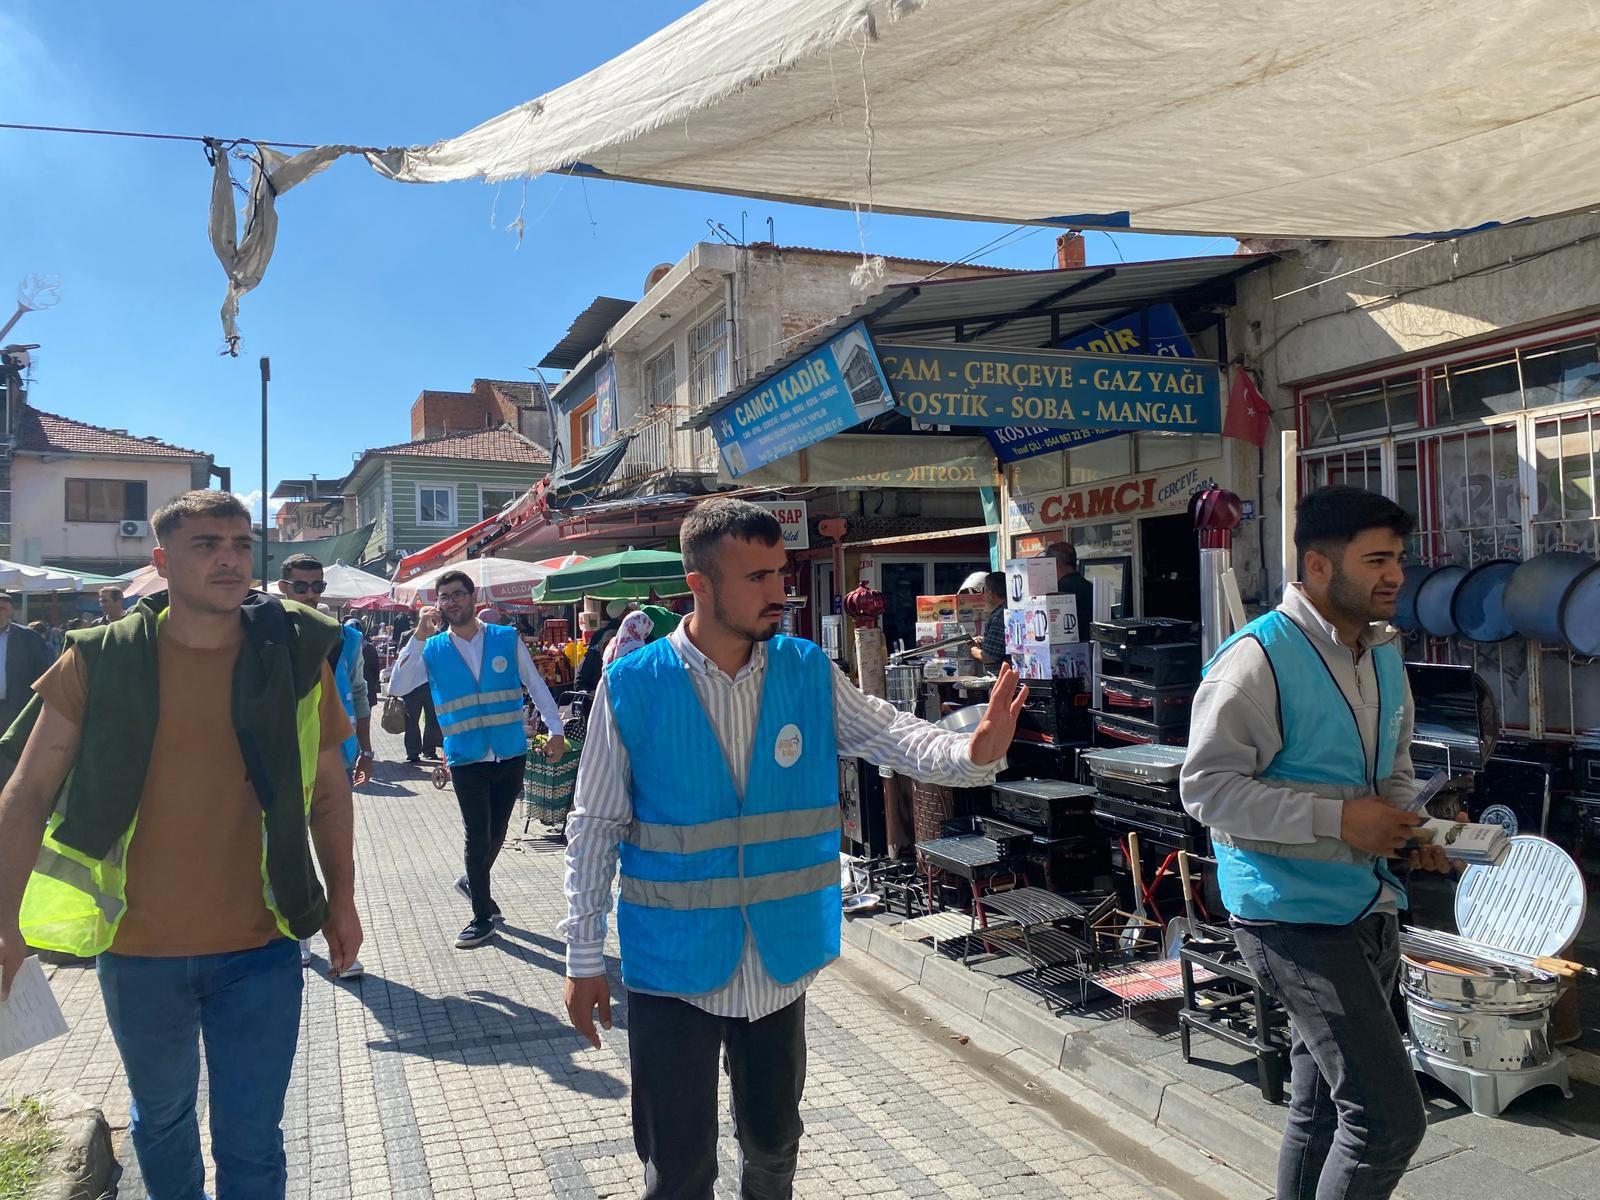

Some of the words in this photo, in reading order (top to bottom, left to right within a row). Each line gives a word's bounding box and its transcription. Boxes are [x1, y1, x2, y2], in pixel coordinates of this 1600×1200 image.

[735, 388, 777, 427] CAMCI
[777, 358, 831, 405] KADİR
[883, 357, 941, 381] CAM
[964, 361, 1073, 392] ÇERÇEVE
[1093, 368, 1142, 392] GAZ
[1147, 365, 1205, 395] YAĞI
[1011, 397, 1076, 422] SOBA
[1096, 401, 1198, 425] MANGAL
[771, 509, 802, 524] SAP
[1039, 478, 1157, 525] CAMCI
